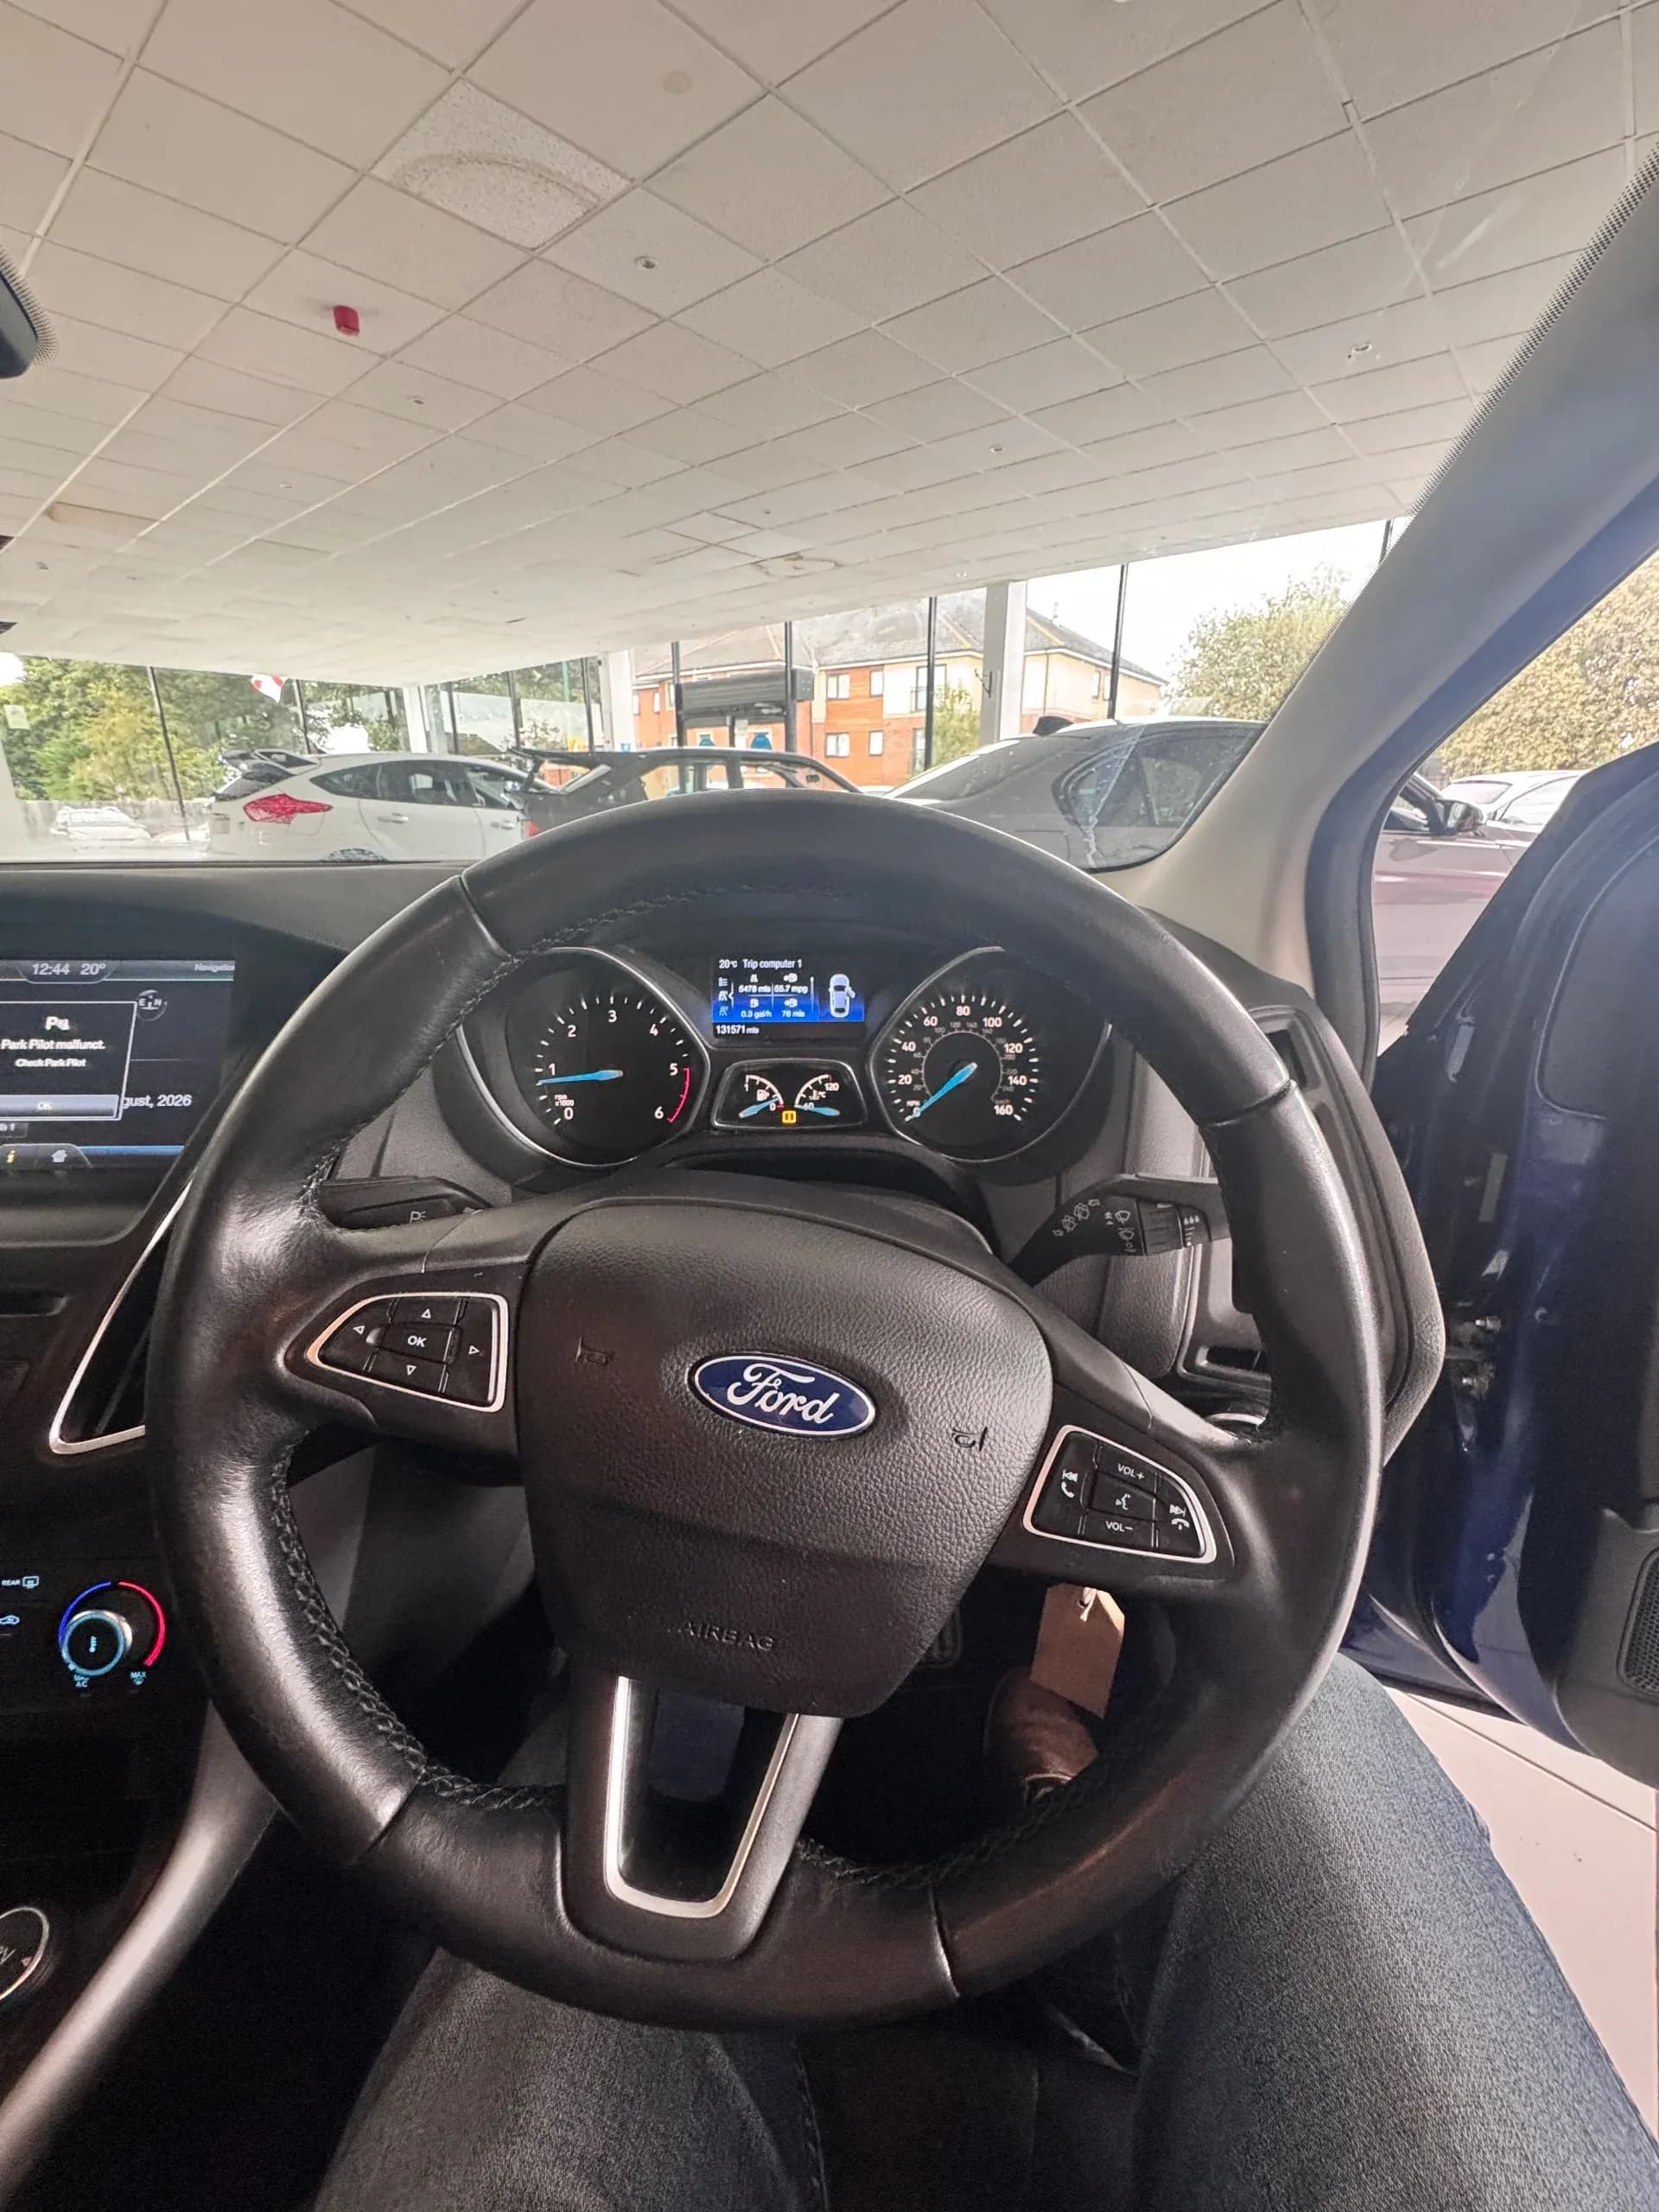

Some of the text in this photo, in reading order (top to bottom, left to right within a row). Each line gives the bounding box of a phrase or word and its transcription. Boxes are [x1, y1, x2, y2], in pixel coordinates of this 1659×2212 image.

[32, 963, 70, 976] 12:44
[742, 958, 803, 969] Trip computer 1
[607, 1009, 618, 1023] 3
[956, 1006, 971, 1016] 80
[923, 1015, 938, 1027] 60
[982, 1017, 1002, 1027] 100
[567, 1025, 577, 1038] 2
[649, 1023, 659, 1037] 4
[715, 1025, 746, 1034] 131571
[1, 1039, 27, 1050] Park
[29, 1039, 55, 1050] Pilot
[901, 1041, 917, 1052] 40
[1003, 1043, 1023, 1054] 120
[15, 1058, 87, 1067] Check Park Pilot
[548, 1063, 556, 1076] 1
[670, 1063, 678, 1076] 5
[898, 1074, 912, 1085] 20
[1007, 1075, 1027, 1086] 140
[824, 1083, 839, 1091] 120
[157, 1095, 192, 1107] 2026
[563, 1107, 574, 1120] 0
[654, 1106, 664, 1119] 6
[994, 1104, 1014, 1116] 160
[407, 1335, 427, 1348] OK
[726, 1363, 838, 1425] Ford
